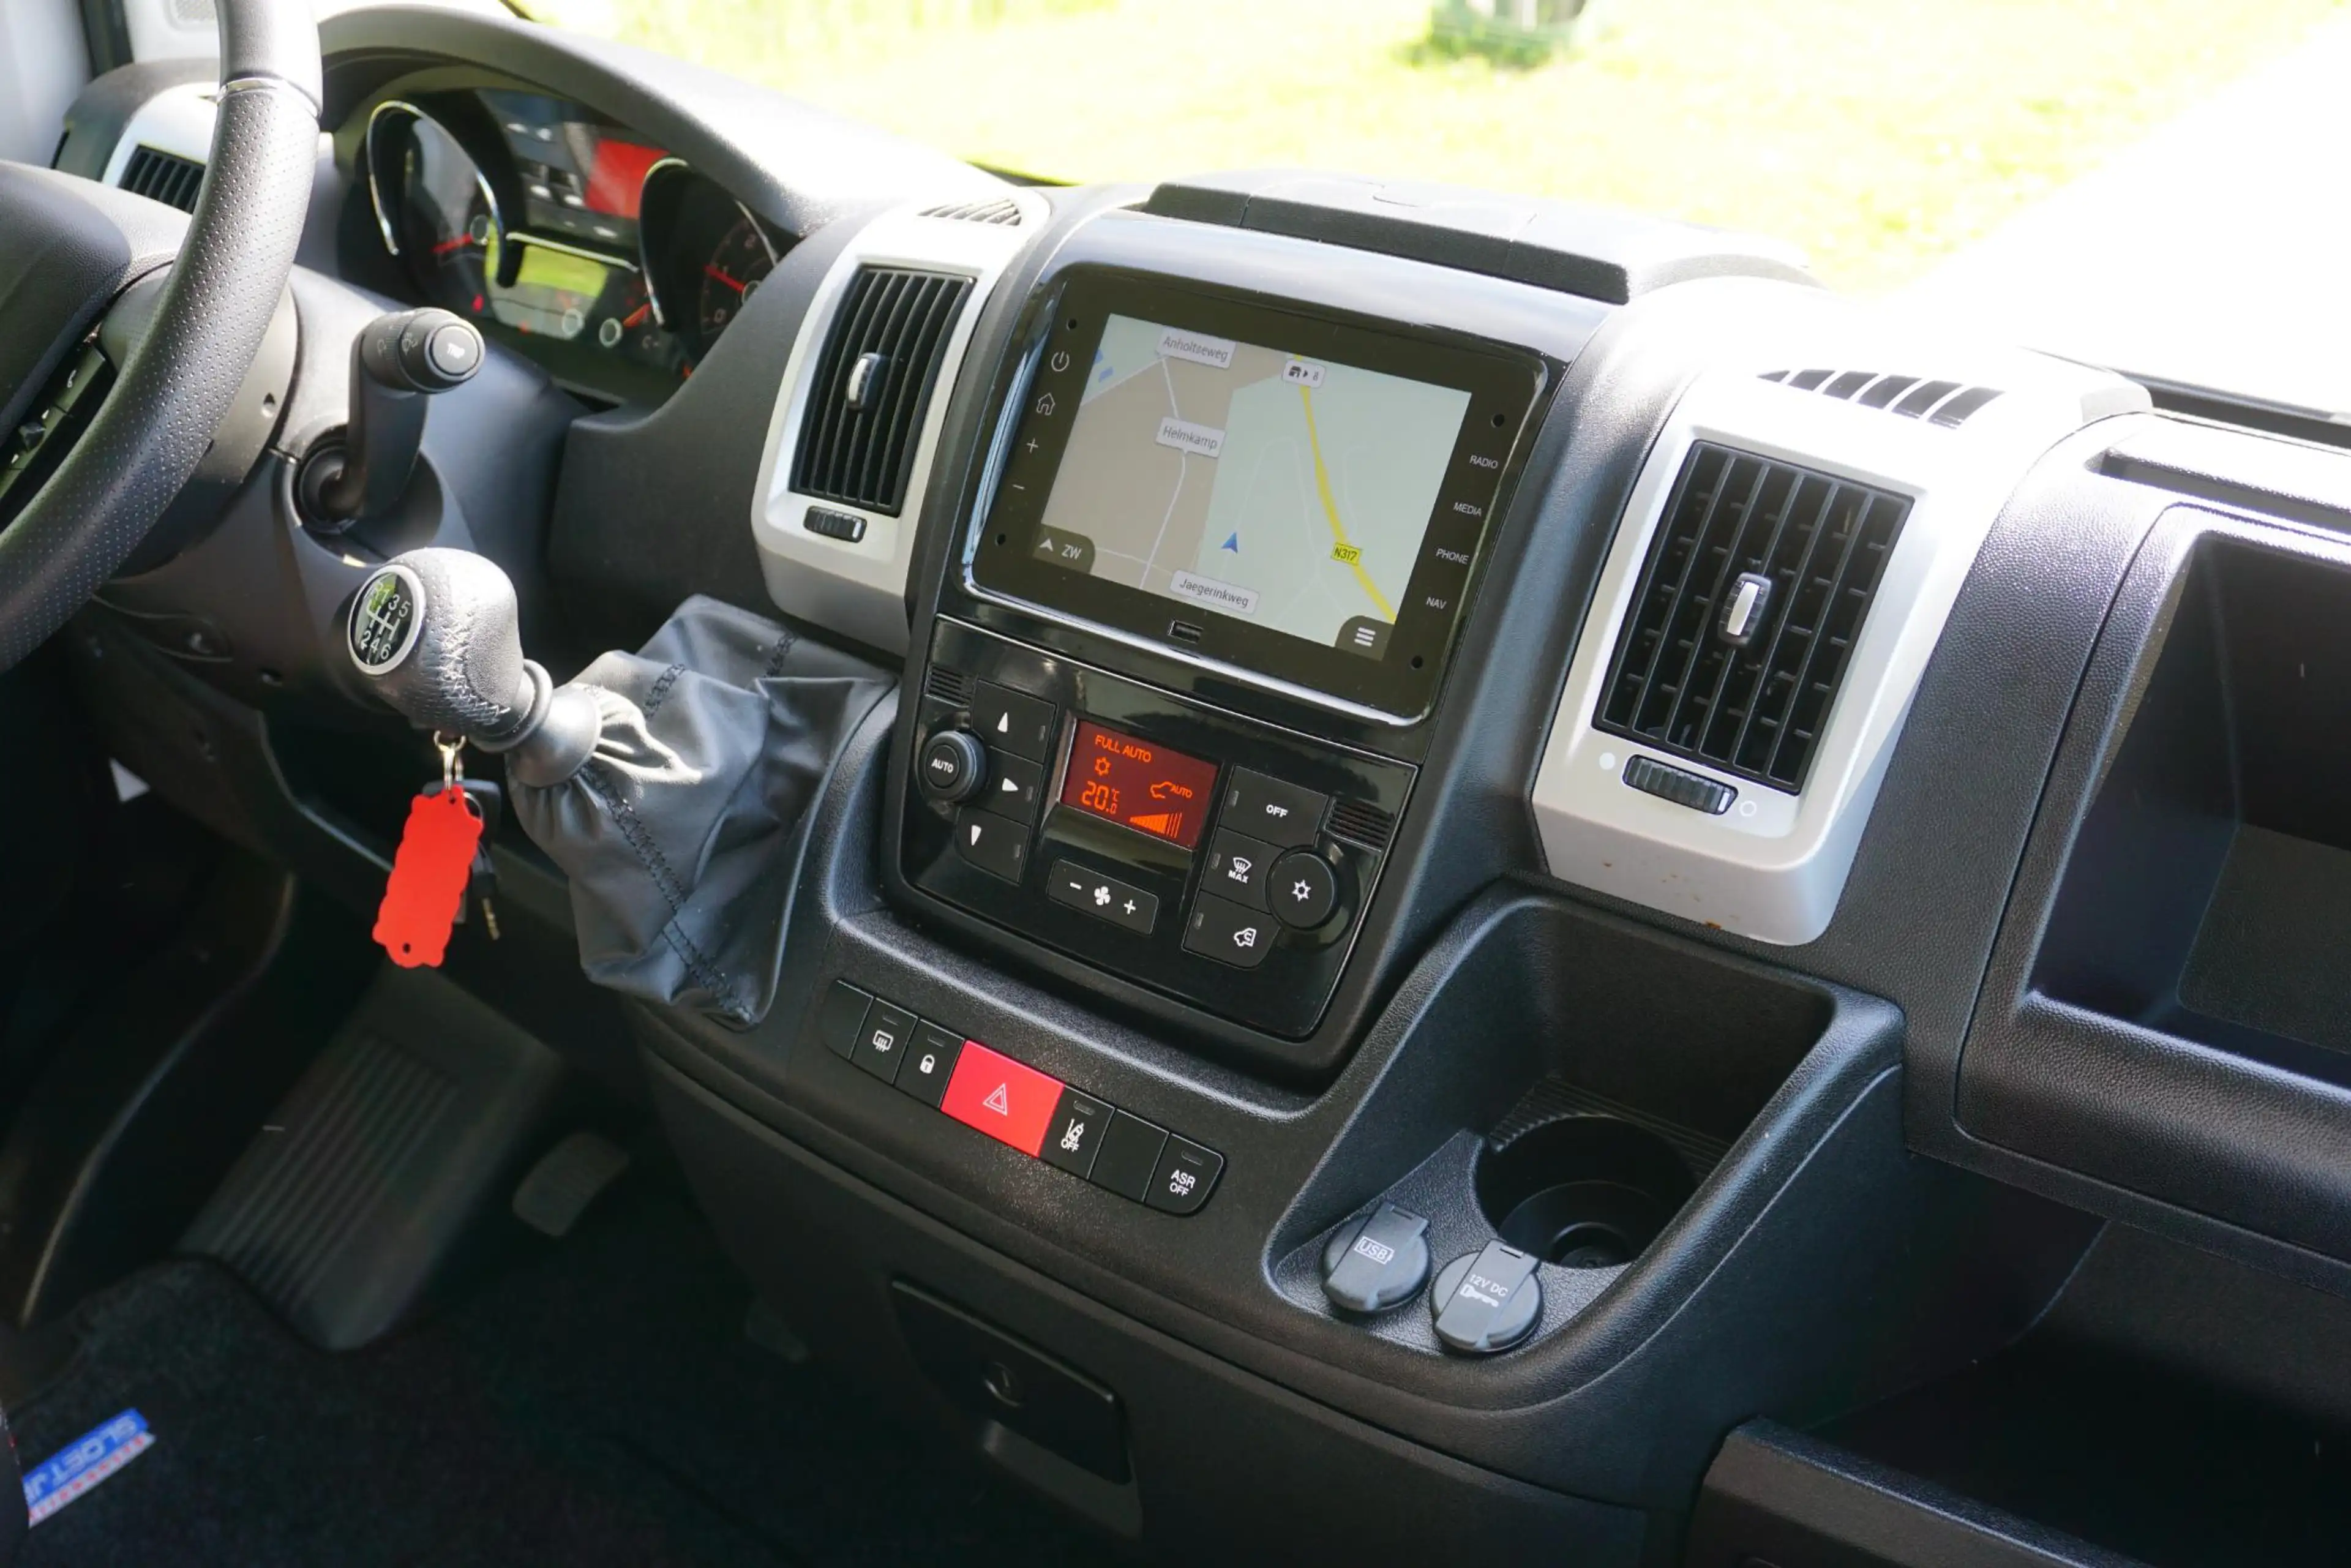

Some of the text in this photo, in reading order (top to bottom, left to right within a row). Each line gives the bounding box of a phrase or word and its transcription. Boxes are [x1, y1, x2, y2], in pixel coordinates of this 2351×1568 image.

[1164, 336, 1229, 362] Anholtseweg
[1163, 426, 1218, 451] Helmkamp
[1469, 455, 1498, 470] RADIO
[1453, 502, 1482, 517] MEDIA
[1062, 544, 1082, 560] ZW
[1334, 547, 1357, 561] N317
[1436, 549, 1469, 565] PHONE
[1179, 579, 1250, 609] Jaegerinkweg
[388, 594, 400, 610] 3
[399, 601, 412, 618] 5
[1426, 597, 1447, 609] NAV
[360, 631, 391, 660] 2 4 6
[1095, 735, 1152, 763] FULL AUTO
[931, 758, 954, 774] AUTO
[1170, 785, 1193, 798] AUTO
[1265, 804, 1289, 818] OFF
[1228, 869, 1249, 883] MAX
[1060, 1137, 1080, 1152] OFF
[1171, 1169, 1196, 1189] ASR
[1169, 1182, 1190, 1197] OFF
[1359, 1240, 1389, 1261] USB
[1469, 1274, 1509, 1297] 12V DC
